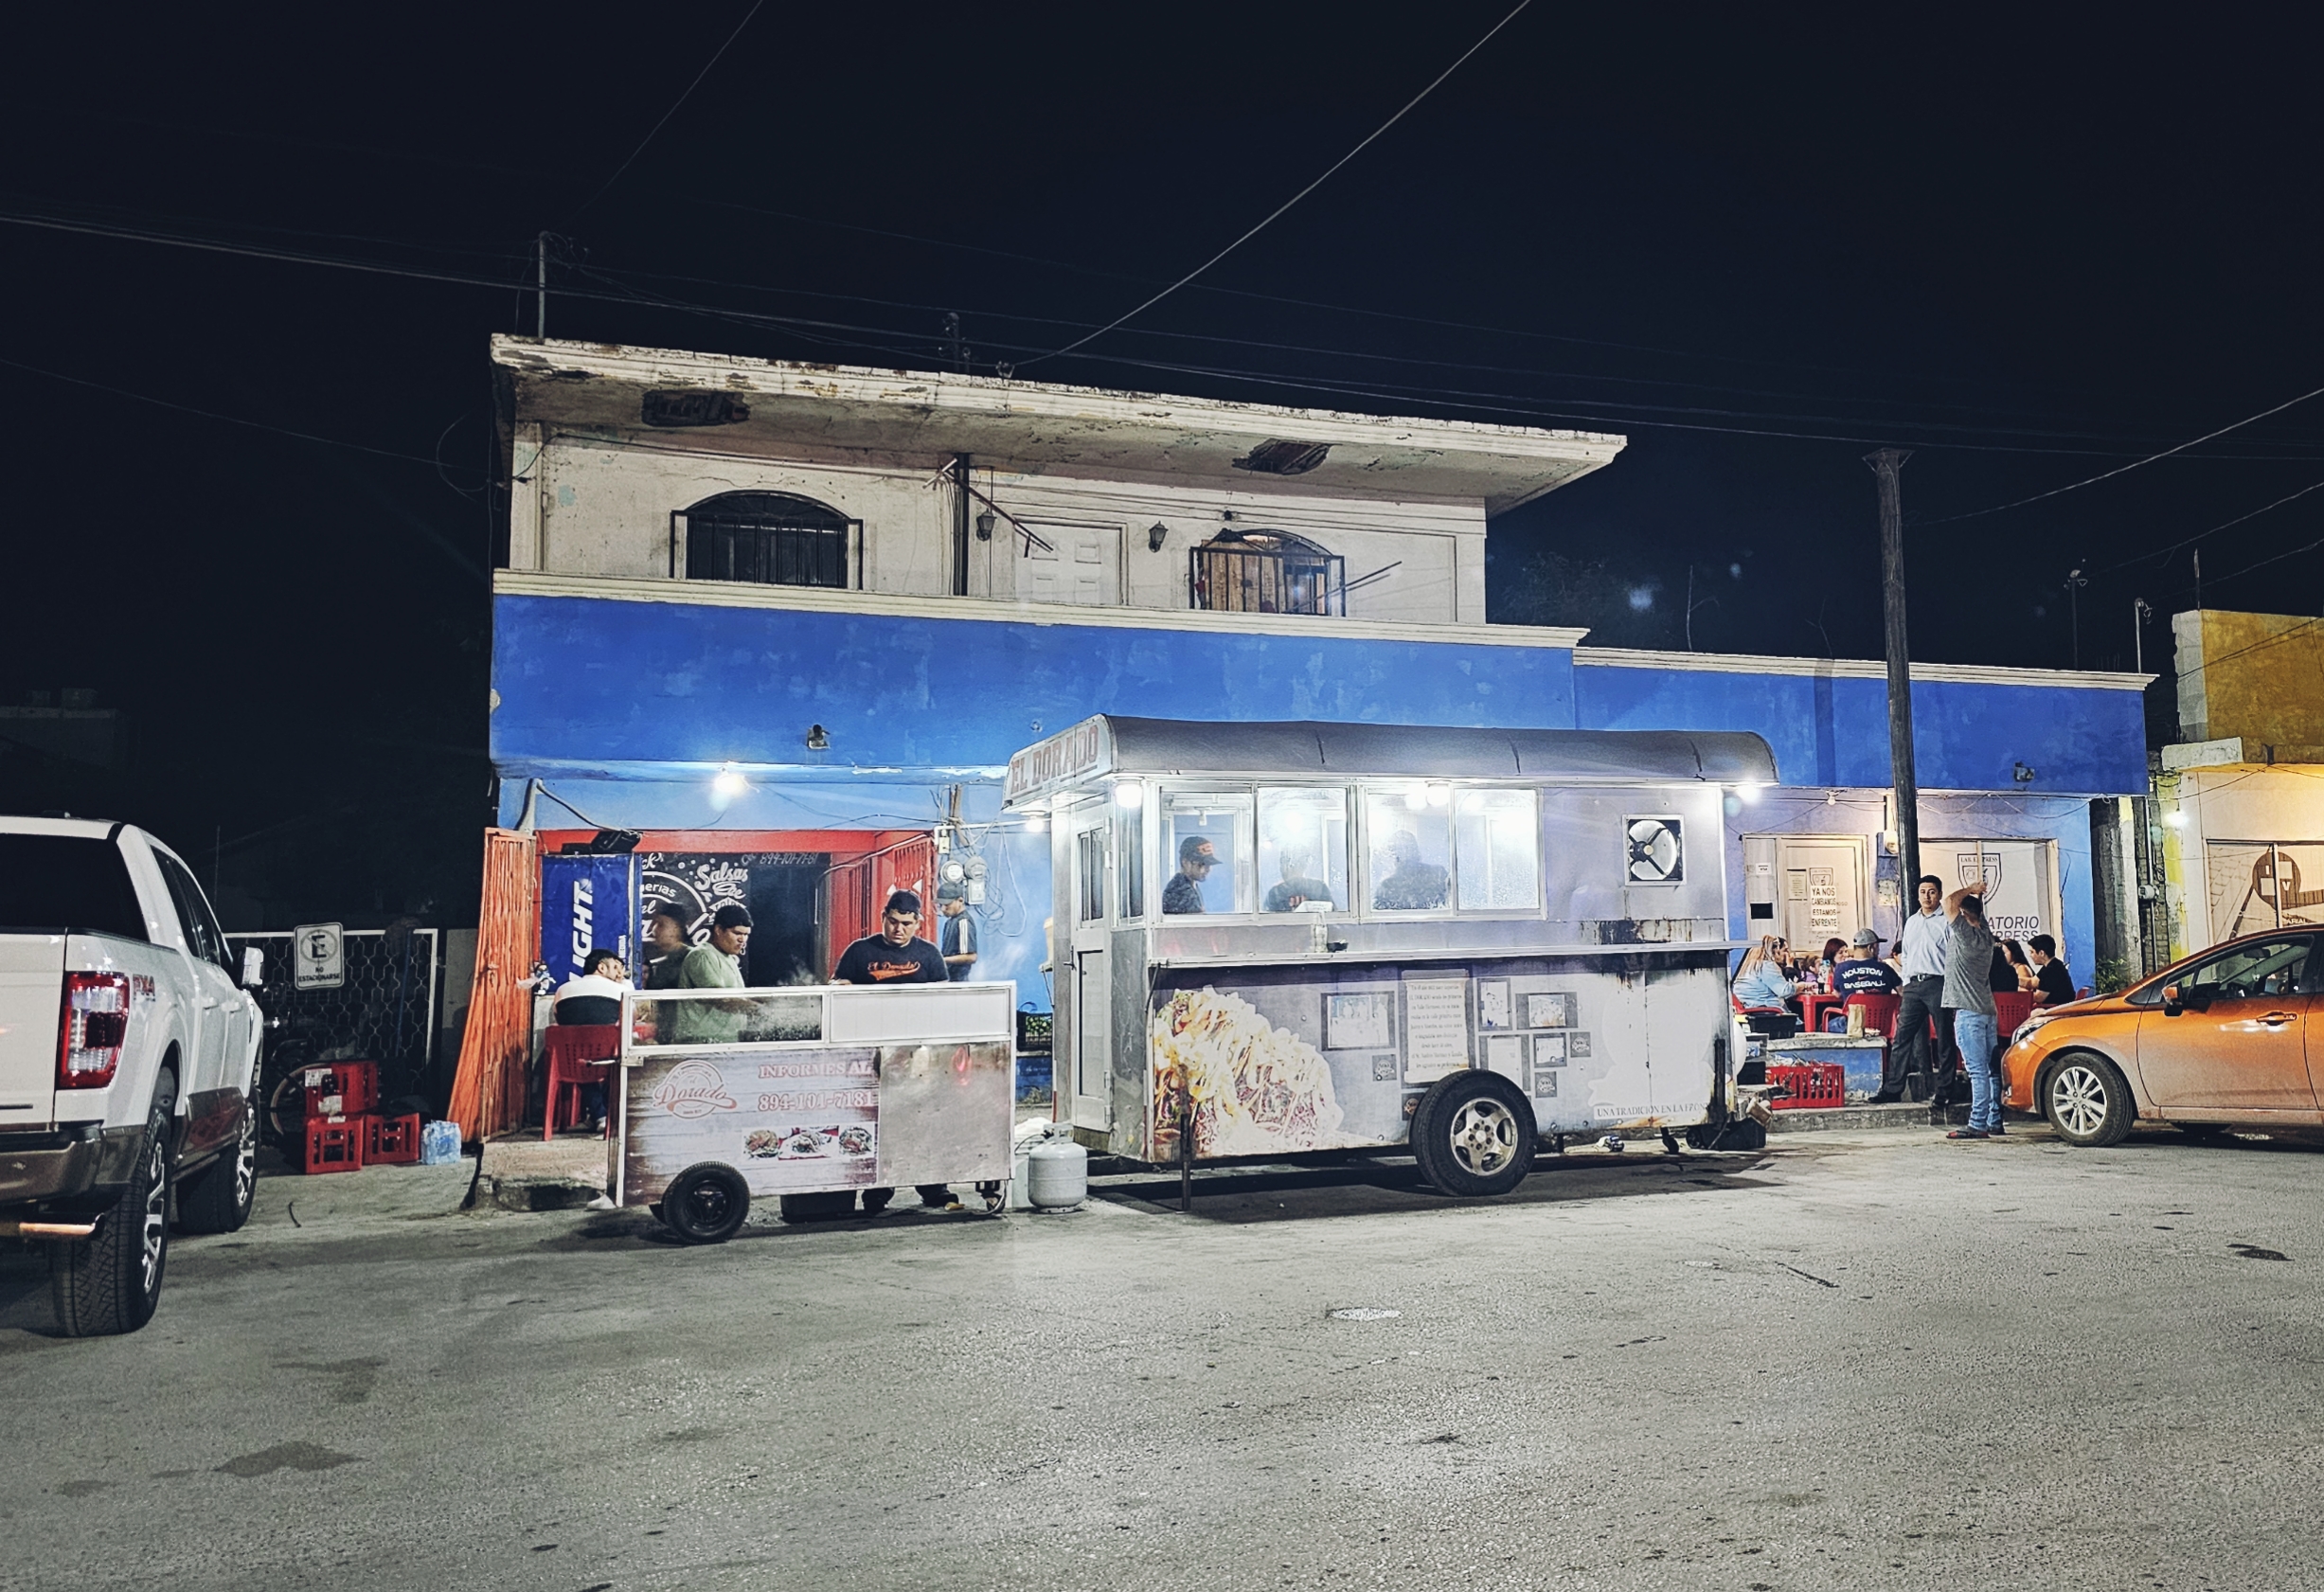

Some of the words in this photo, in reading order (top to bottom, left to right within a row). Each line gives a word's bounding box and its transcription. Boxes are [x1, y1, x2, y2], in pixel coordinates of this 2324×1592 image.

[1010, 758, 1028, 795] EL
[1031, 724, 1099, 786] DORADO
[694, 861, 748, 891] Salsas
[641, 882, 677, 899] erias
[1812, 887, 1821, 896] YA
[1822, 887, 1835, 896] NOS
[1811, 919, 1837, 927] ENFRENTE
[1989, 916, 2039, 929] ATORIO
[1993, 930, 2038, 942] PRESS
[298, 973, 341, 982] ESTACIONARSE
[1841, 967, 1884, 979] HOUSTON
[1843, 980, 1886, 990] BASEBALL
[758, 1062, 846, 1078] INFORMES
[849, 1060, 872, 1076] AL
[653, 1082, 727, 1107] Dorado
[758, 1090, 874, 1112] 894-101-7181
[1597, 1107, 1615, 1118] UNA
[1661, 1105, 1671, 1114] EN
[1673, 1104, 1684, 1113] LA
